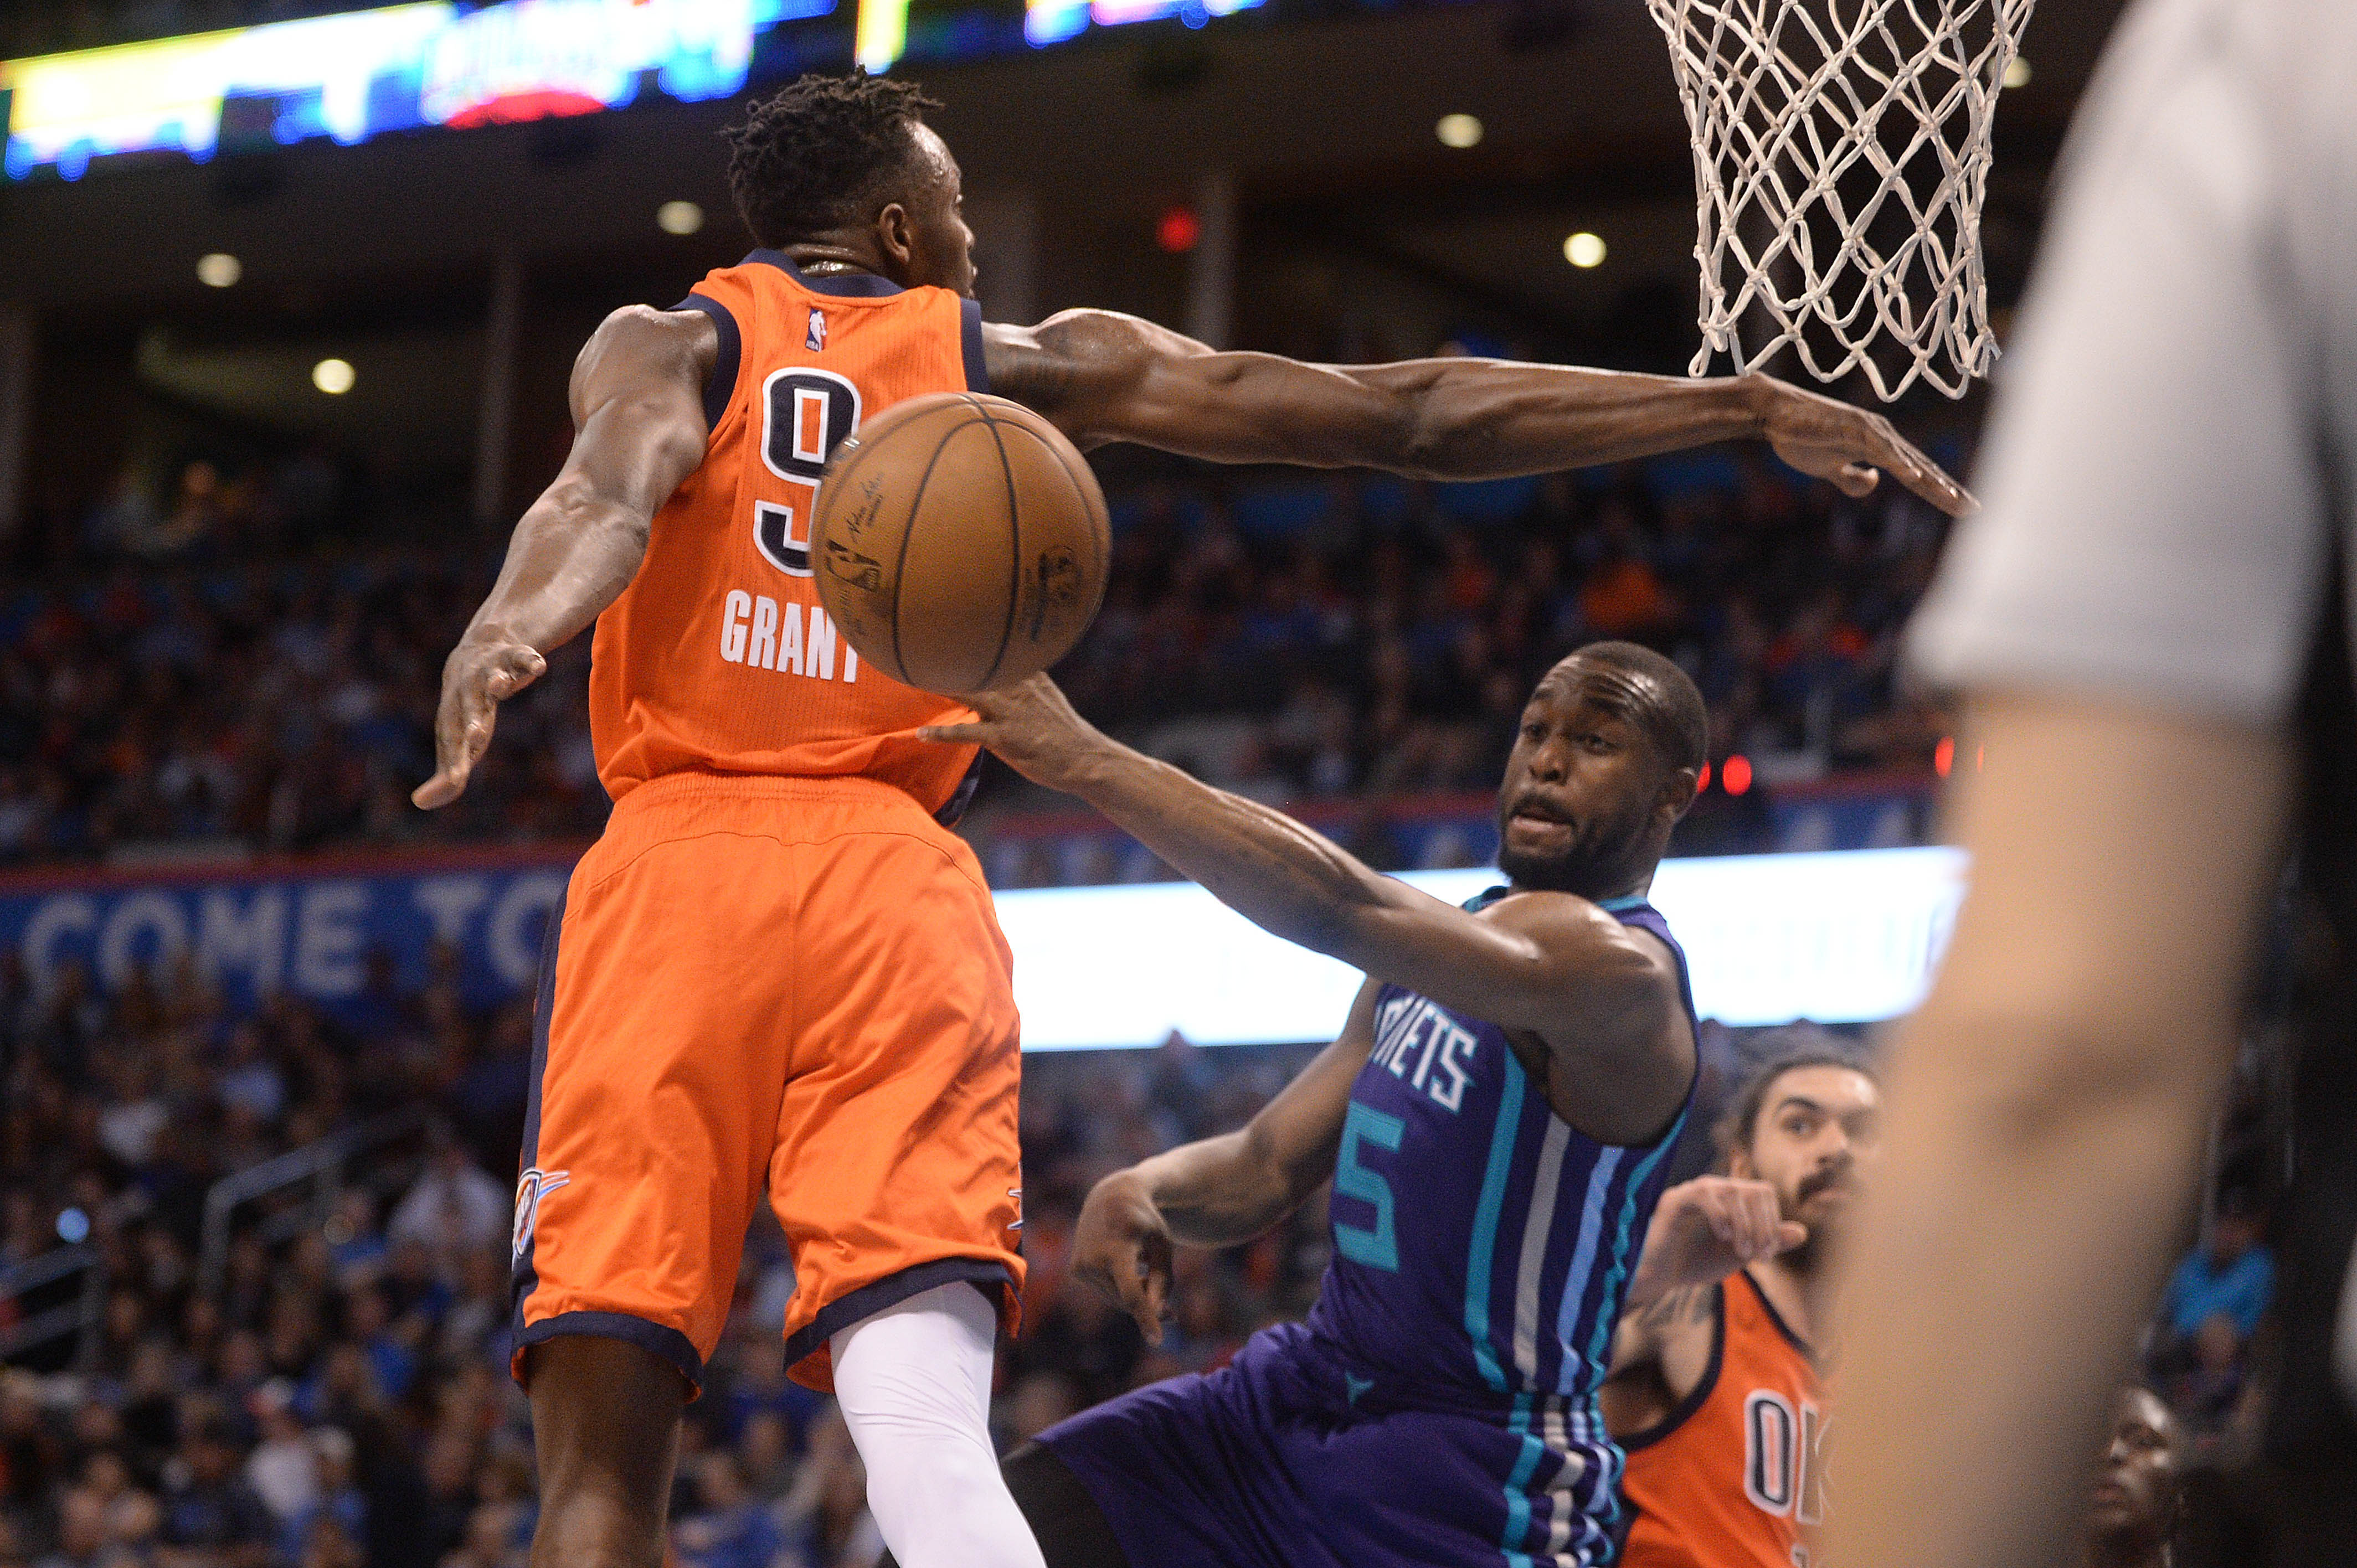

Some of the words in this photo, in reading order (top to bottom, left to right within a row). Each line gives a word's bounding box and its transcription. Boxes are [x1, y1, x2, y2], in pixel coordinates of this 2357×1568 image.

[753, 367, 862, 577] 9
[22, 880, 370, 1005] COME
[1335, 1099, 1407, 1273] 5
